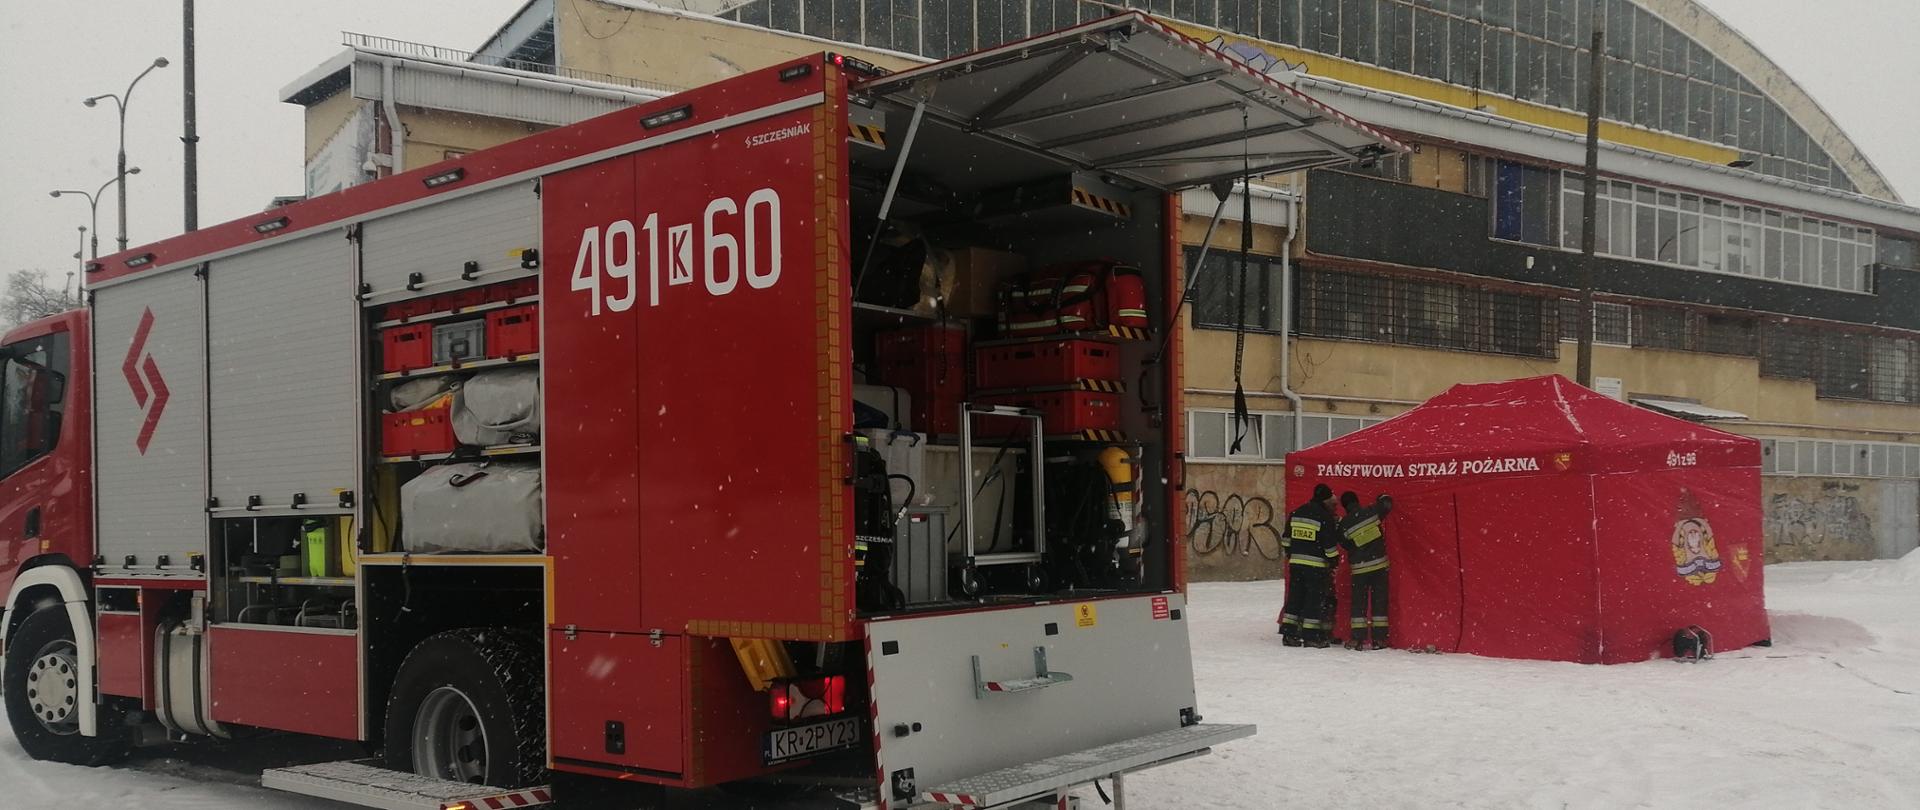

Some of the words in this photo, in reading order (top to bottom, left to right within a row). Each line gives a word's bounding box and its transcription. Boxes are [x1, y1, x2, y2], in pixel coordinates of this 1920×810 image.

[1317, 462, 1404, 478] PAŃSTWOWA
[1408, 459, 1457, 477] STRAŻ
[1461, 456, 1540, 475] POŻARNA
[775, 731, 798, 757] KR
[805, 720, 856, 751] 2PY23
